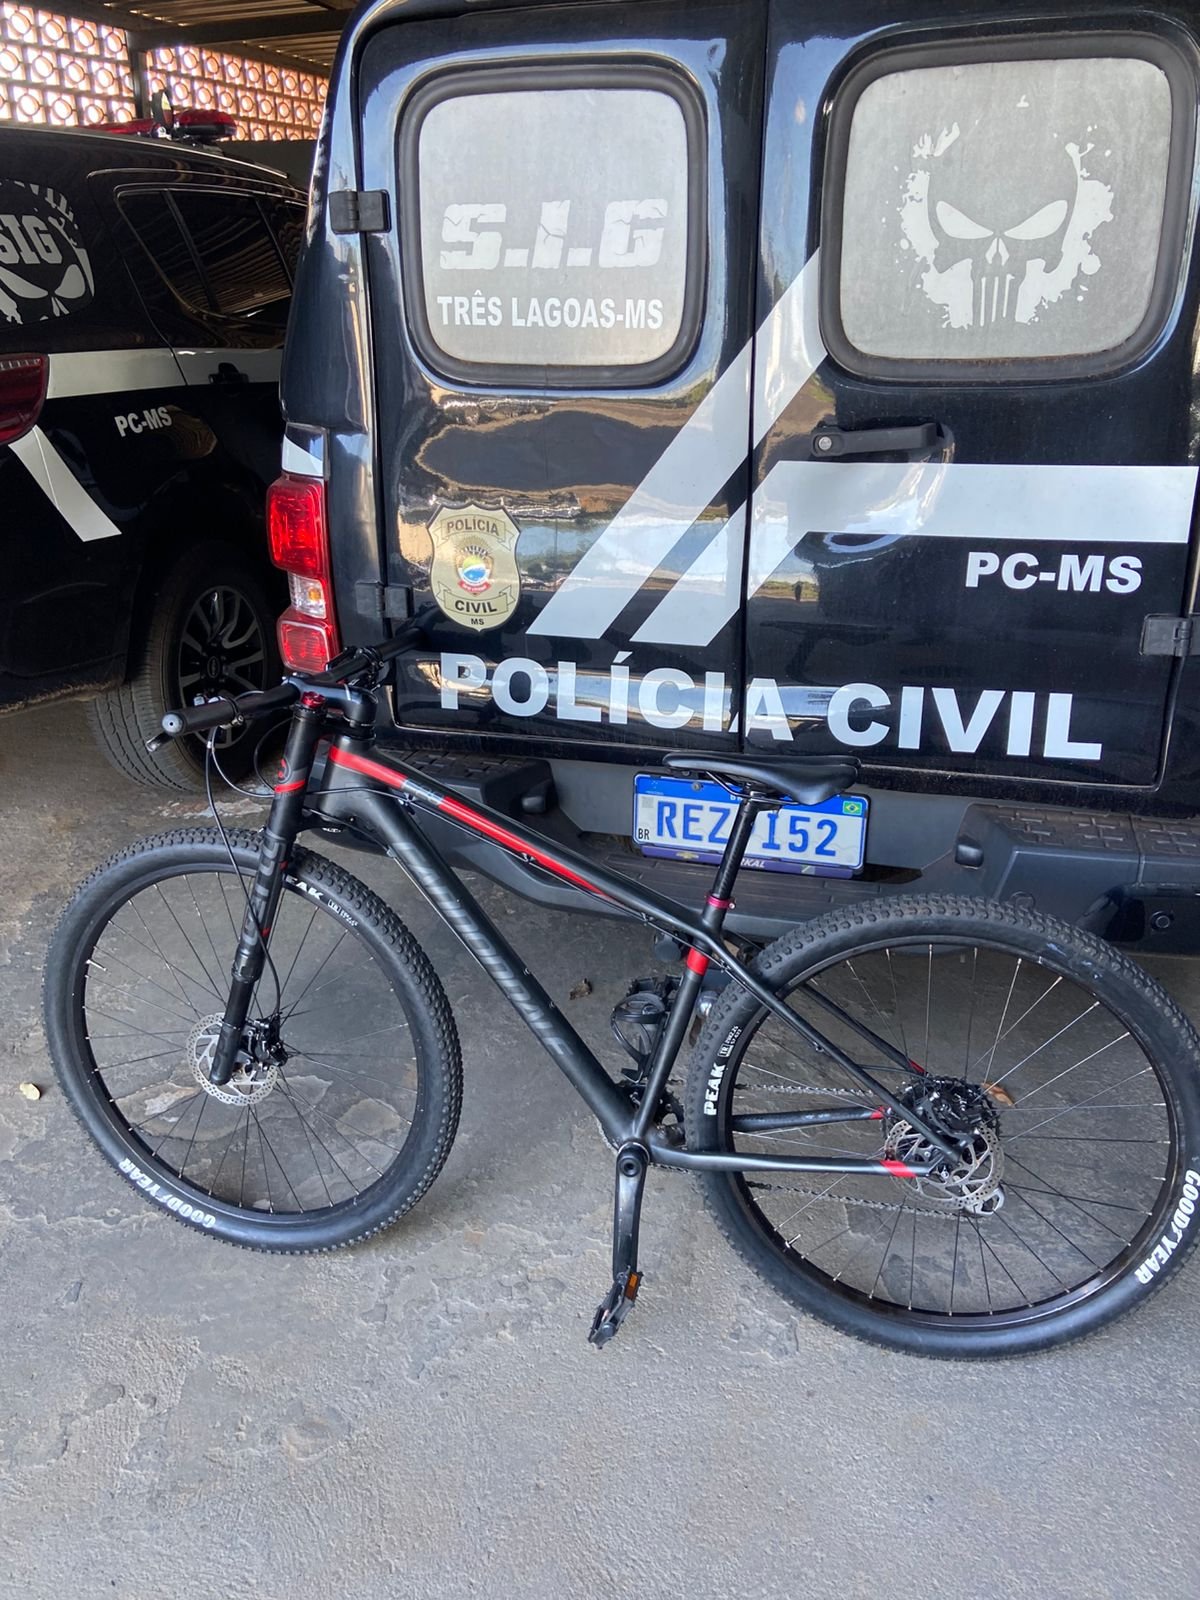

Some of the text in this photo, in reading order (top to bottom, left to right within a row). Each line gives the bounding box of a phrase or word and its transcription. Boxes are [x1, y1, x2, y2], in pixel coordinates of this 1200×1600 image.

[437, 289, 664, 329] TRÊS LAGOAS-MS
[114, 407, 172, 437] PC-MS
[447, 517, 499, 536] POLÍCIA
[965, 551, 1143, 594] PC-MS
[455, 600, 497, 613] CIVIL
[440, 651, 1103, 762] POLÍCIA CIVIL
[638, 828, 650, 840] BR
[703, 1062, 726, 1116] PEAK
